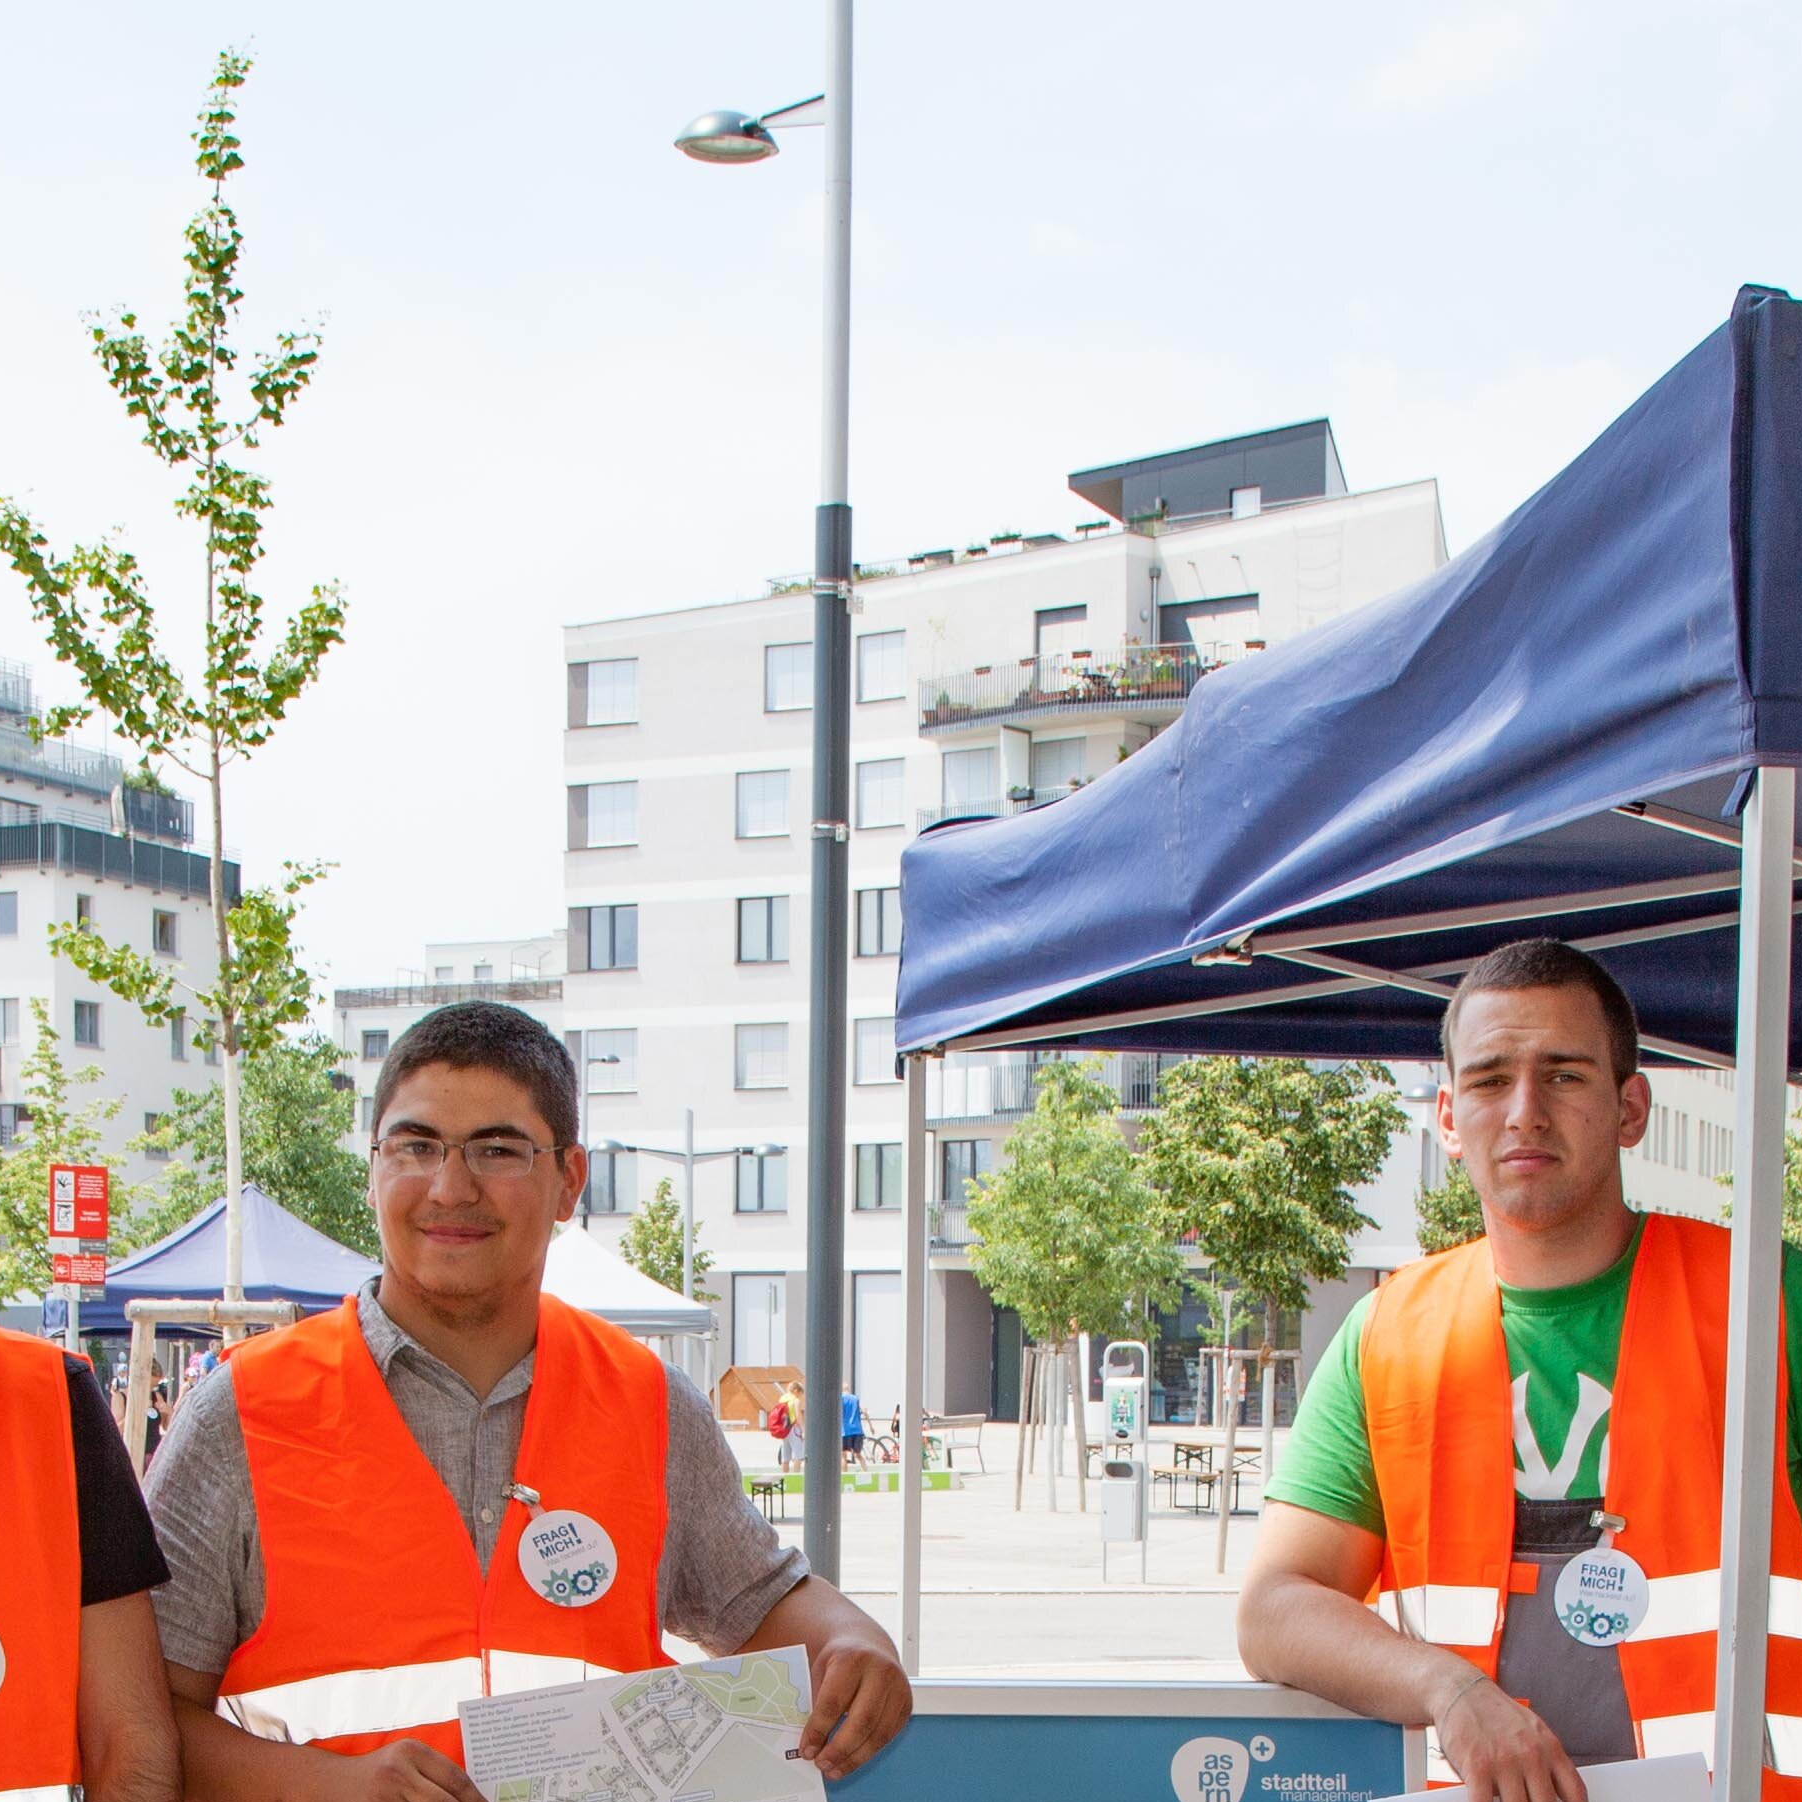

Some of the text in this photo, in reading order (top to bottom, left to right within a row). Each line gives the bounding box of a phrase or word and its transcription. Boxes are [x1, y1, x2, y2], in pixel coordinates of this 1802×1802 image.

[532, 1525, 569, 1548] FRAG
[1581, 1563, 1618, 1578] FRAG
[1204, 1754, 1233, 1770] as
[1198, 1770, 1230, 1792] pe
[1261, 1773, 1346, 1791] stadtteil
